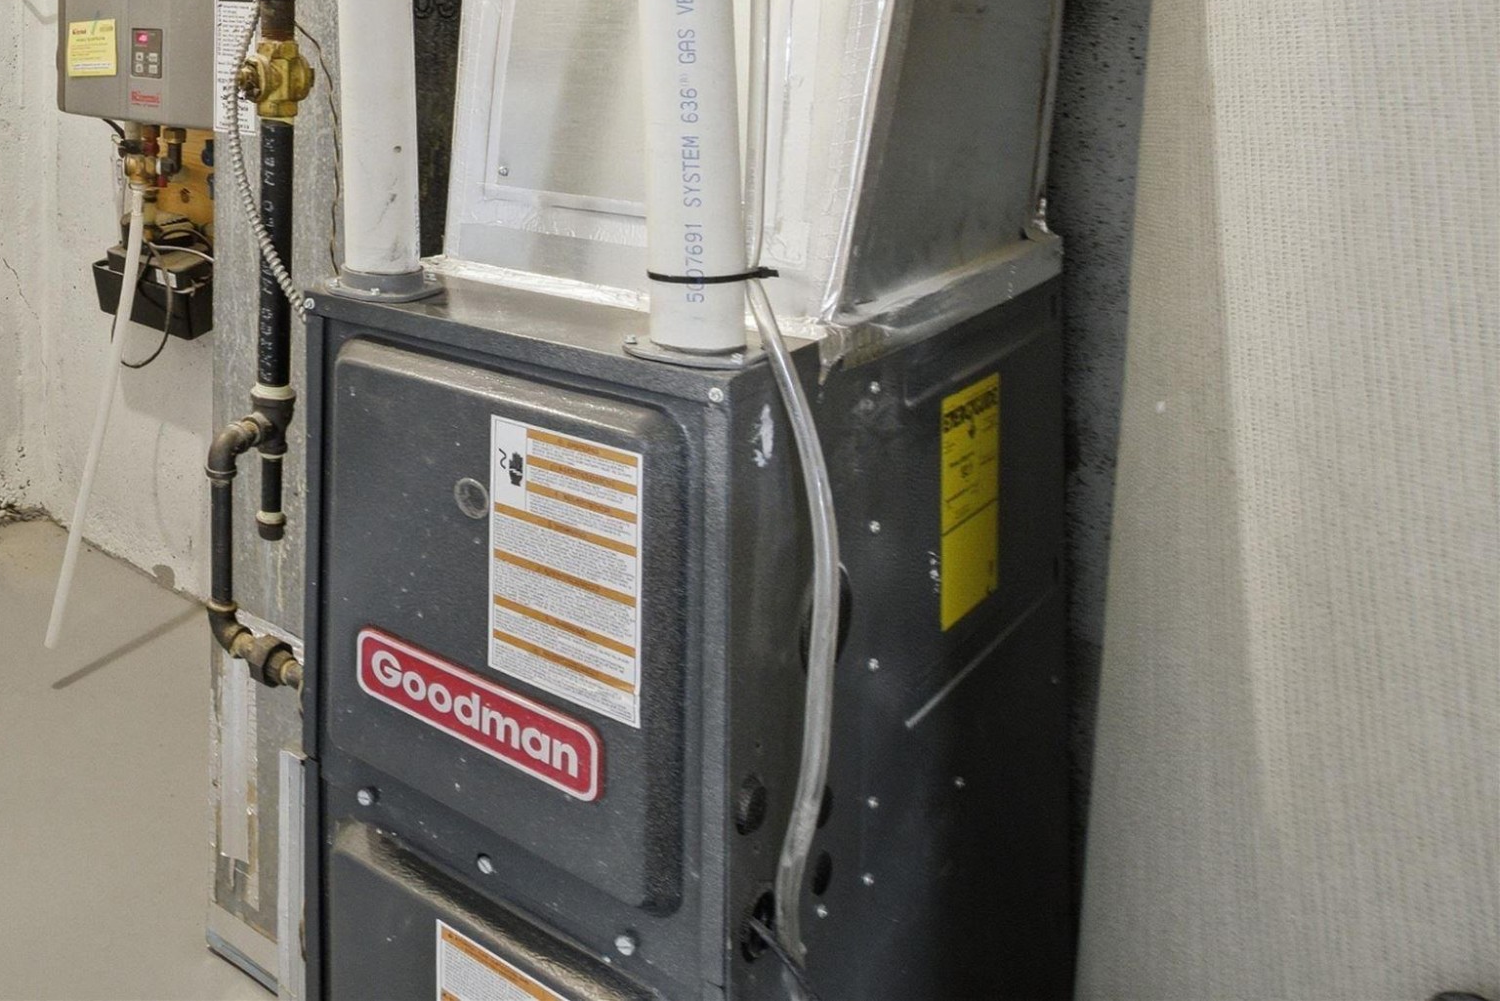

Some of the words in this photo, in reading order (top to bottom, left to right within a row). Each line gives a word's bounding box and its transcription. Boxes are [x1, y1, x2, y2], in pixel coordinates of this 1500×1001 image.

[678, 28, 696, 66] GAS
[682, 135, 703, 207] SYSTEM
[370, 650, 579, 778] Goodman
